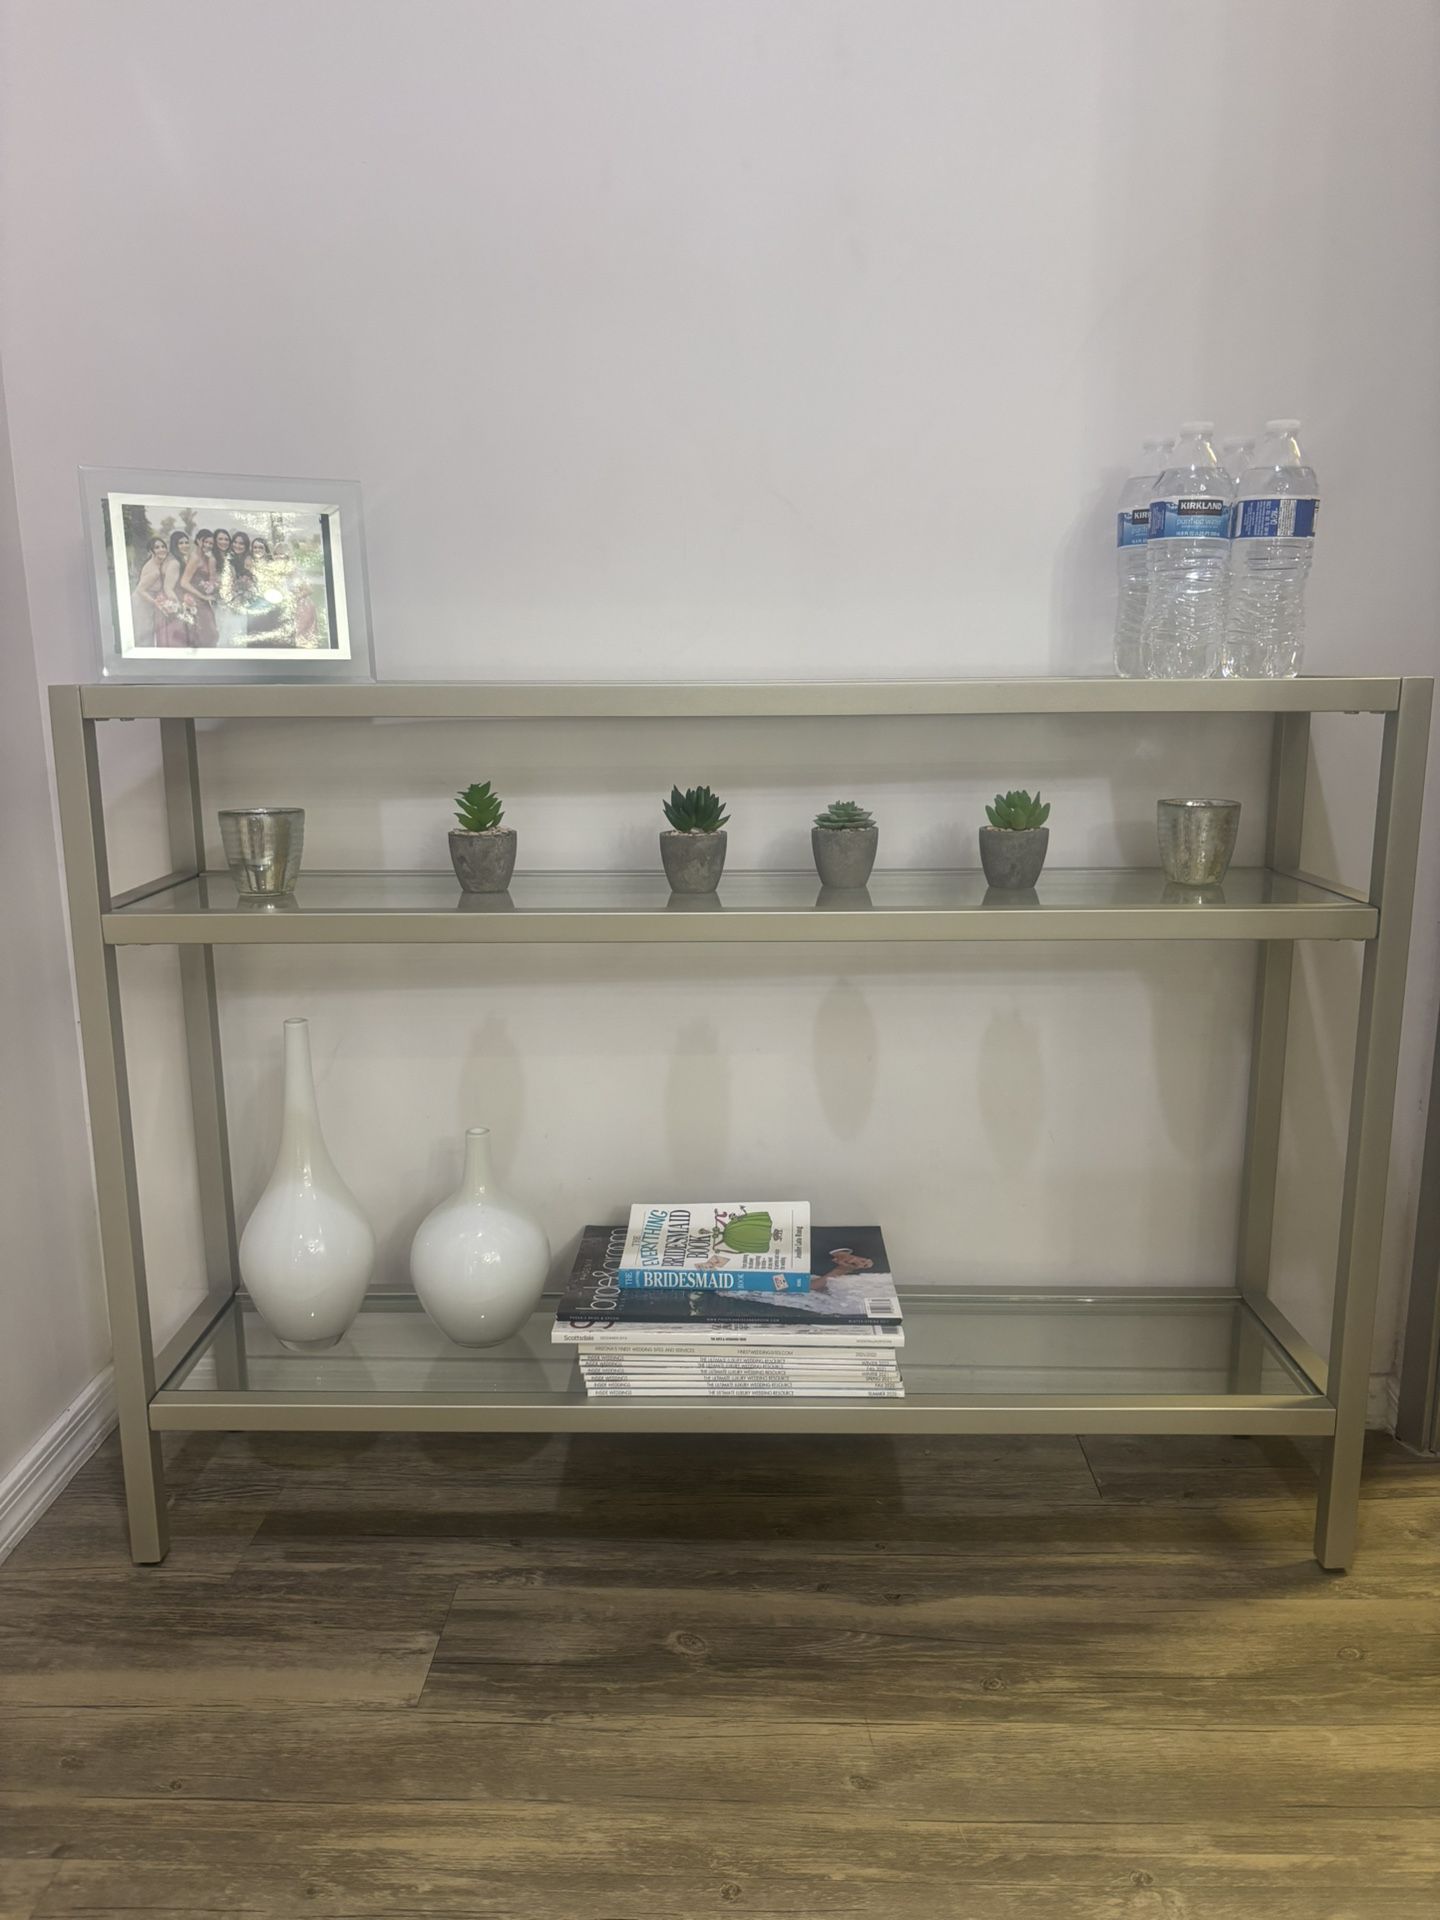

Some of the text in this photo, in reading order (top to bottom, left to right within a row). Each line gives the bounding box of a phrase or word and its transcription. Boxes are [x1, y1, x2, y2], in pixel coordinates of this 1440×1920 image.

[1180, 501, 1222, 510] KIRKLAND
[1176, 518, 1204, 526] purified
[640, 1209, 668, 1267] EVERYTHING
[661, 1209, 691, 1267] BRIDESMAID
[686, 1235, 711, 1259] BOOK
[643, 1272, 734, 1289] BRIDESMAID
[564, 1334, 594, 1342] Scottsdale
